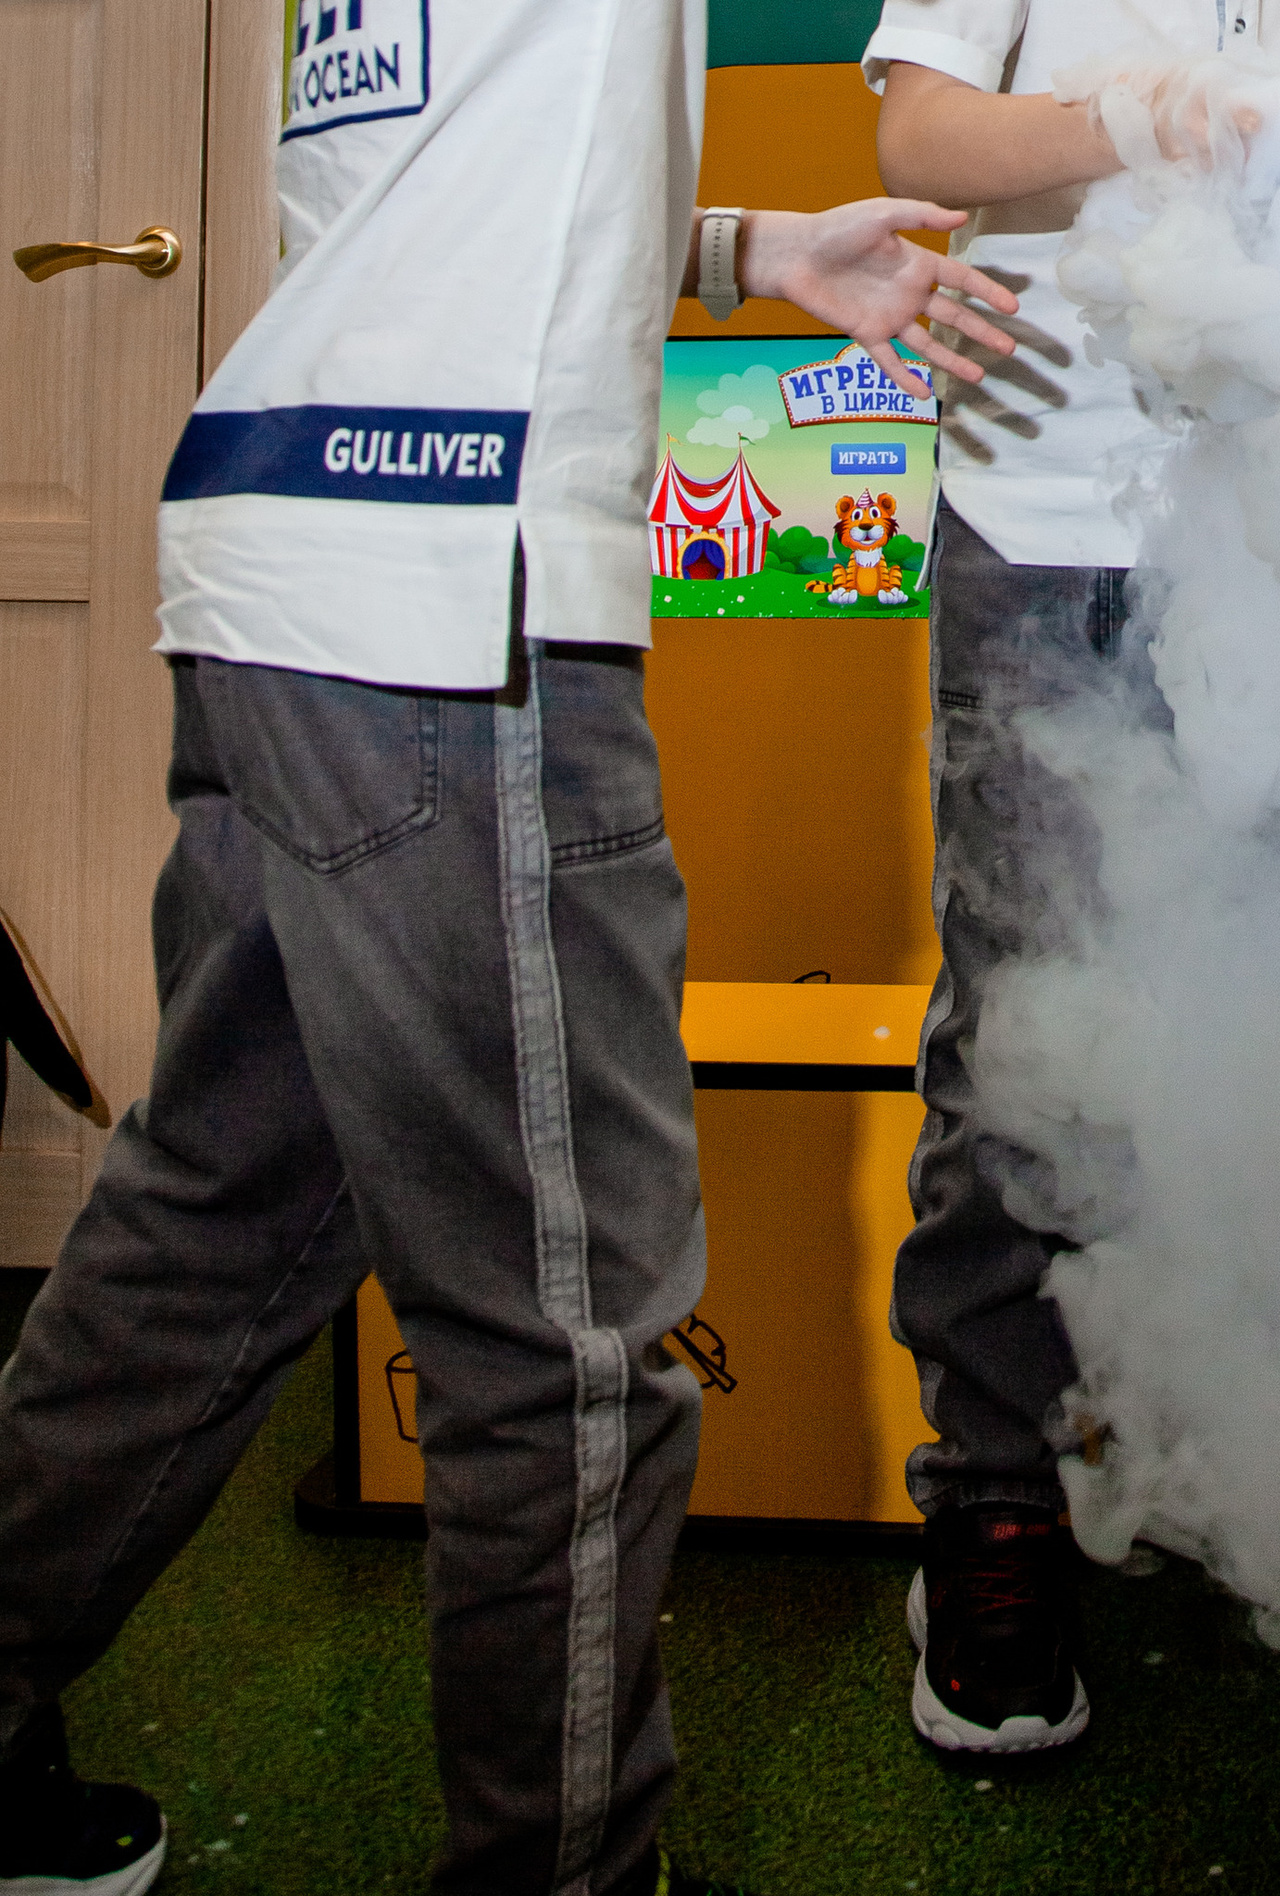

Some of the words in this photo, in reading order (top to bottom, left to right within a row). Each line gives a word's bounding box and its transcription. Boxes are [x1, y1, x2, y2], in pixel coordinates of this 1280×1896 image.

[304, 42, 400, 108] OCEAN
[821, 395, 835, 414] В
[844, 392, 915, 413] ЦИРКЕ
[324, 427, 506, 477] GULLIVER
[838, 451, 898, 465] ИГРАТЬ
